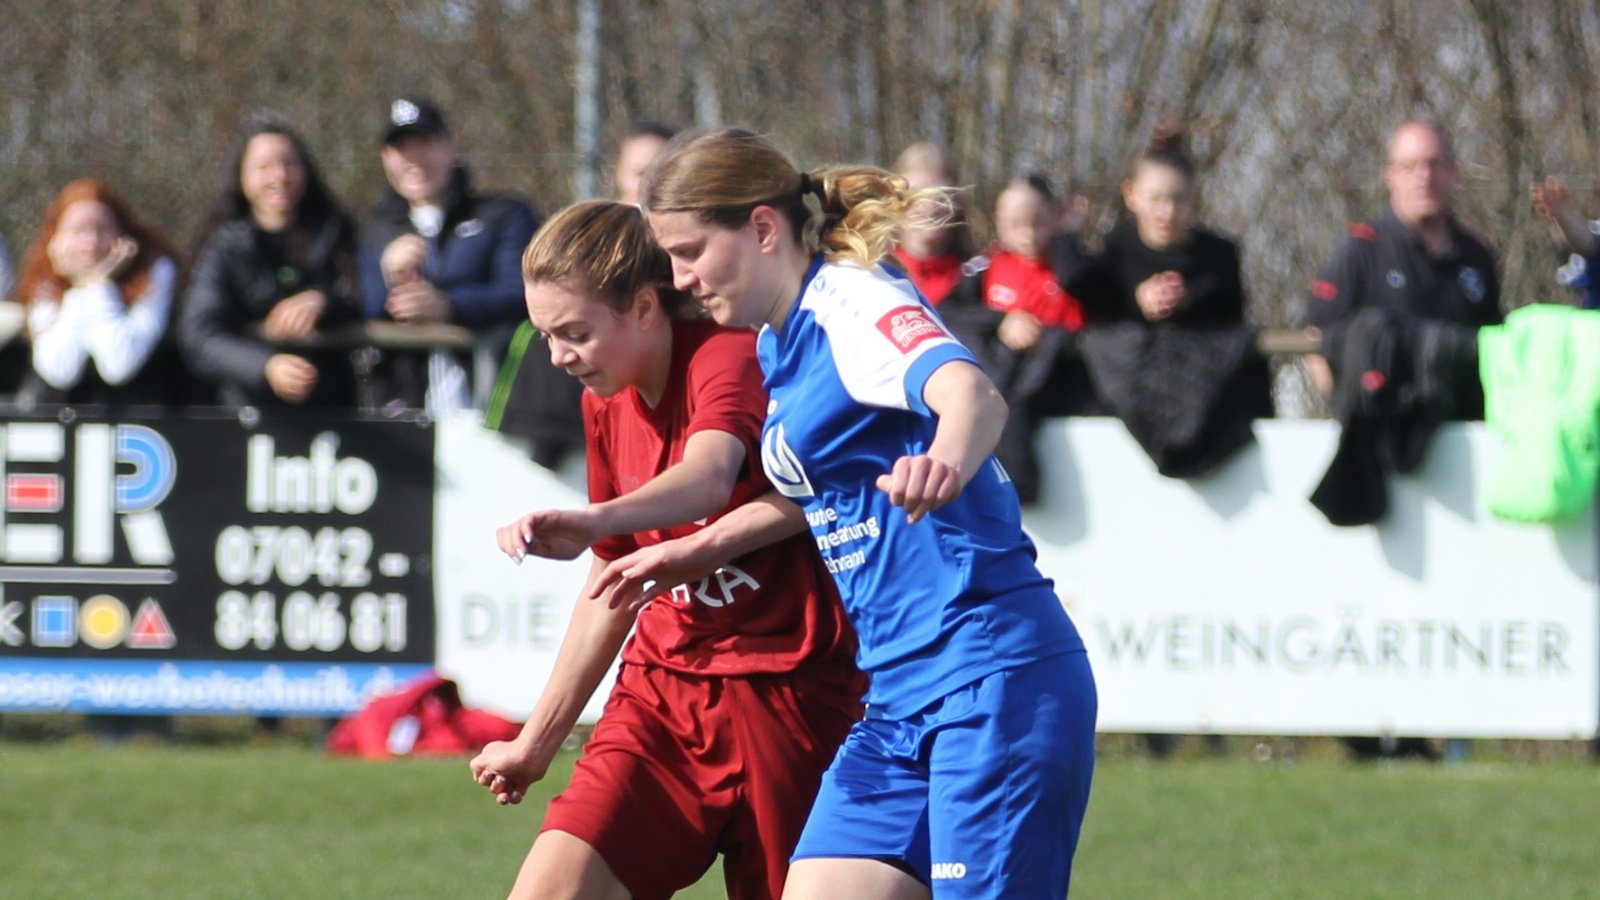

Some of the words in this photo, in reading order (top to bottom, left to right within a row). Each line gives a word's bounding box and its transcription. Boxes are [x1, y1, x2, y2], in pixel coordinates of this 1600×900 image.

[246, 432, 378, 515] Info
[214, 525, 374, 587] 07042
[214, 591, 278, 651] 84
[282, 591, 346, 652] 06
[349, 592, 407, 652] 81
[461, 594, 551, 645] DIE
[1096, 604, 1571, 674] WEINGÄRTNER
